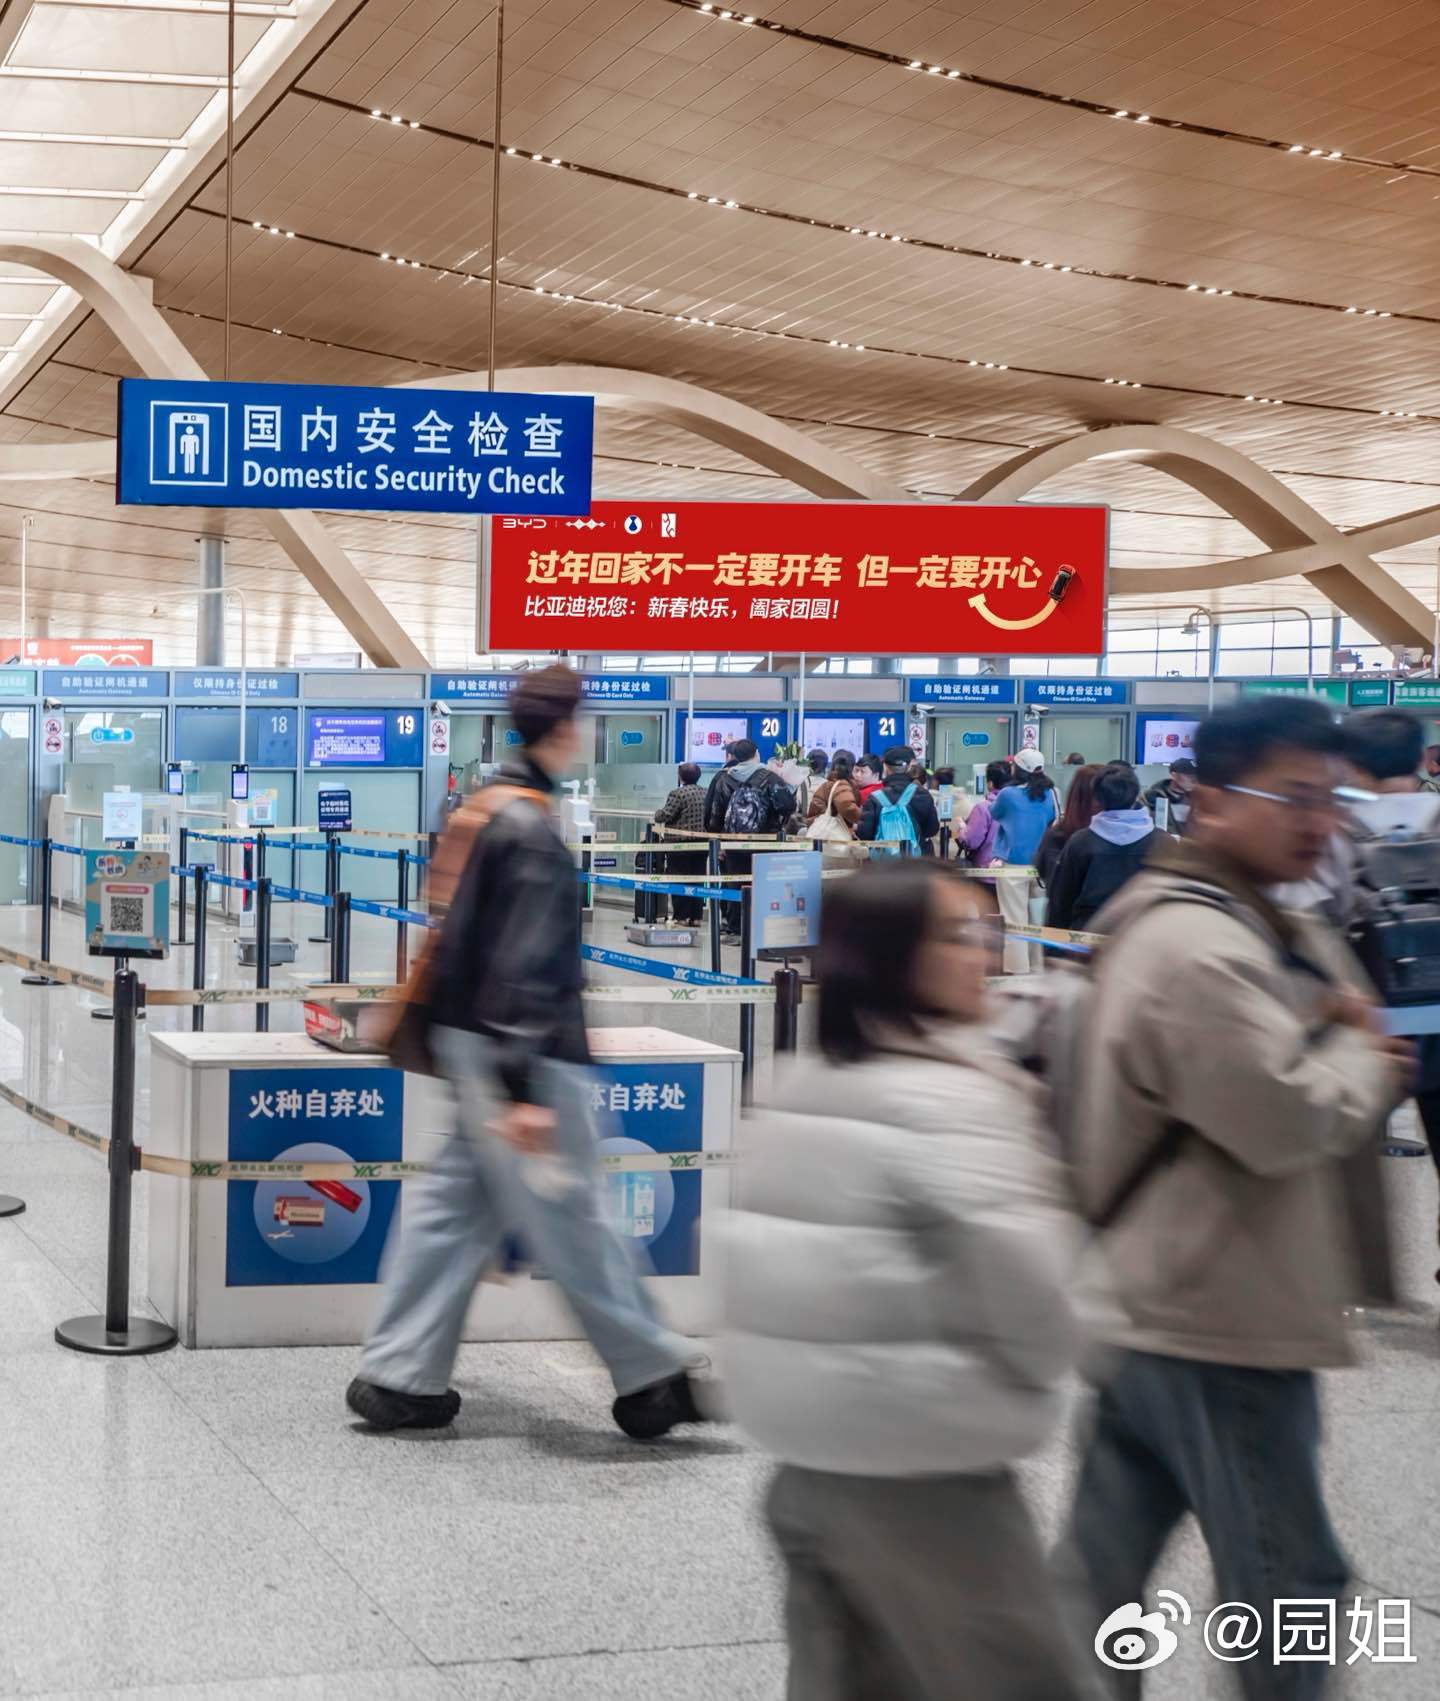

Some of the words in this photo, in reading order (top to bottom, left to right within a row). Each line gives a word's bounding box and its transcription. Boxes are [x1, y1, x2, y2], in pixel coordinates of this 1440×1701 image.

[243, 404, 564, 459] 国内安全检查
[244, 460, 368, 490] Domestic
[375, 464, 482, 499] Security
[488, 466, 565, 495] Check
[502, 518, 548, 529] BYD
[526, 550, 842, 587] 过年回家不一定要开车
[856, 553, 1042, 589] 但一定要开心
[271, 716, 288, 734] 18
[397, 715, 415, 735] 19
[761, 718, 780, 737] 20
[879, 717, 896, 736] 21
[249, 1089, 385, 1118] 火种自弃处
